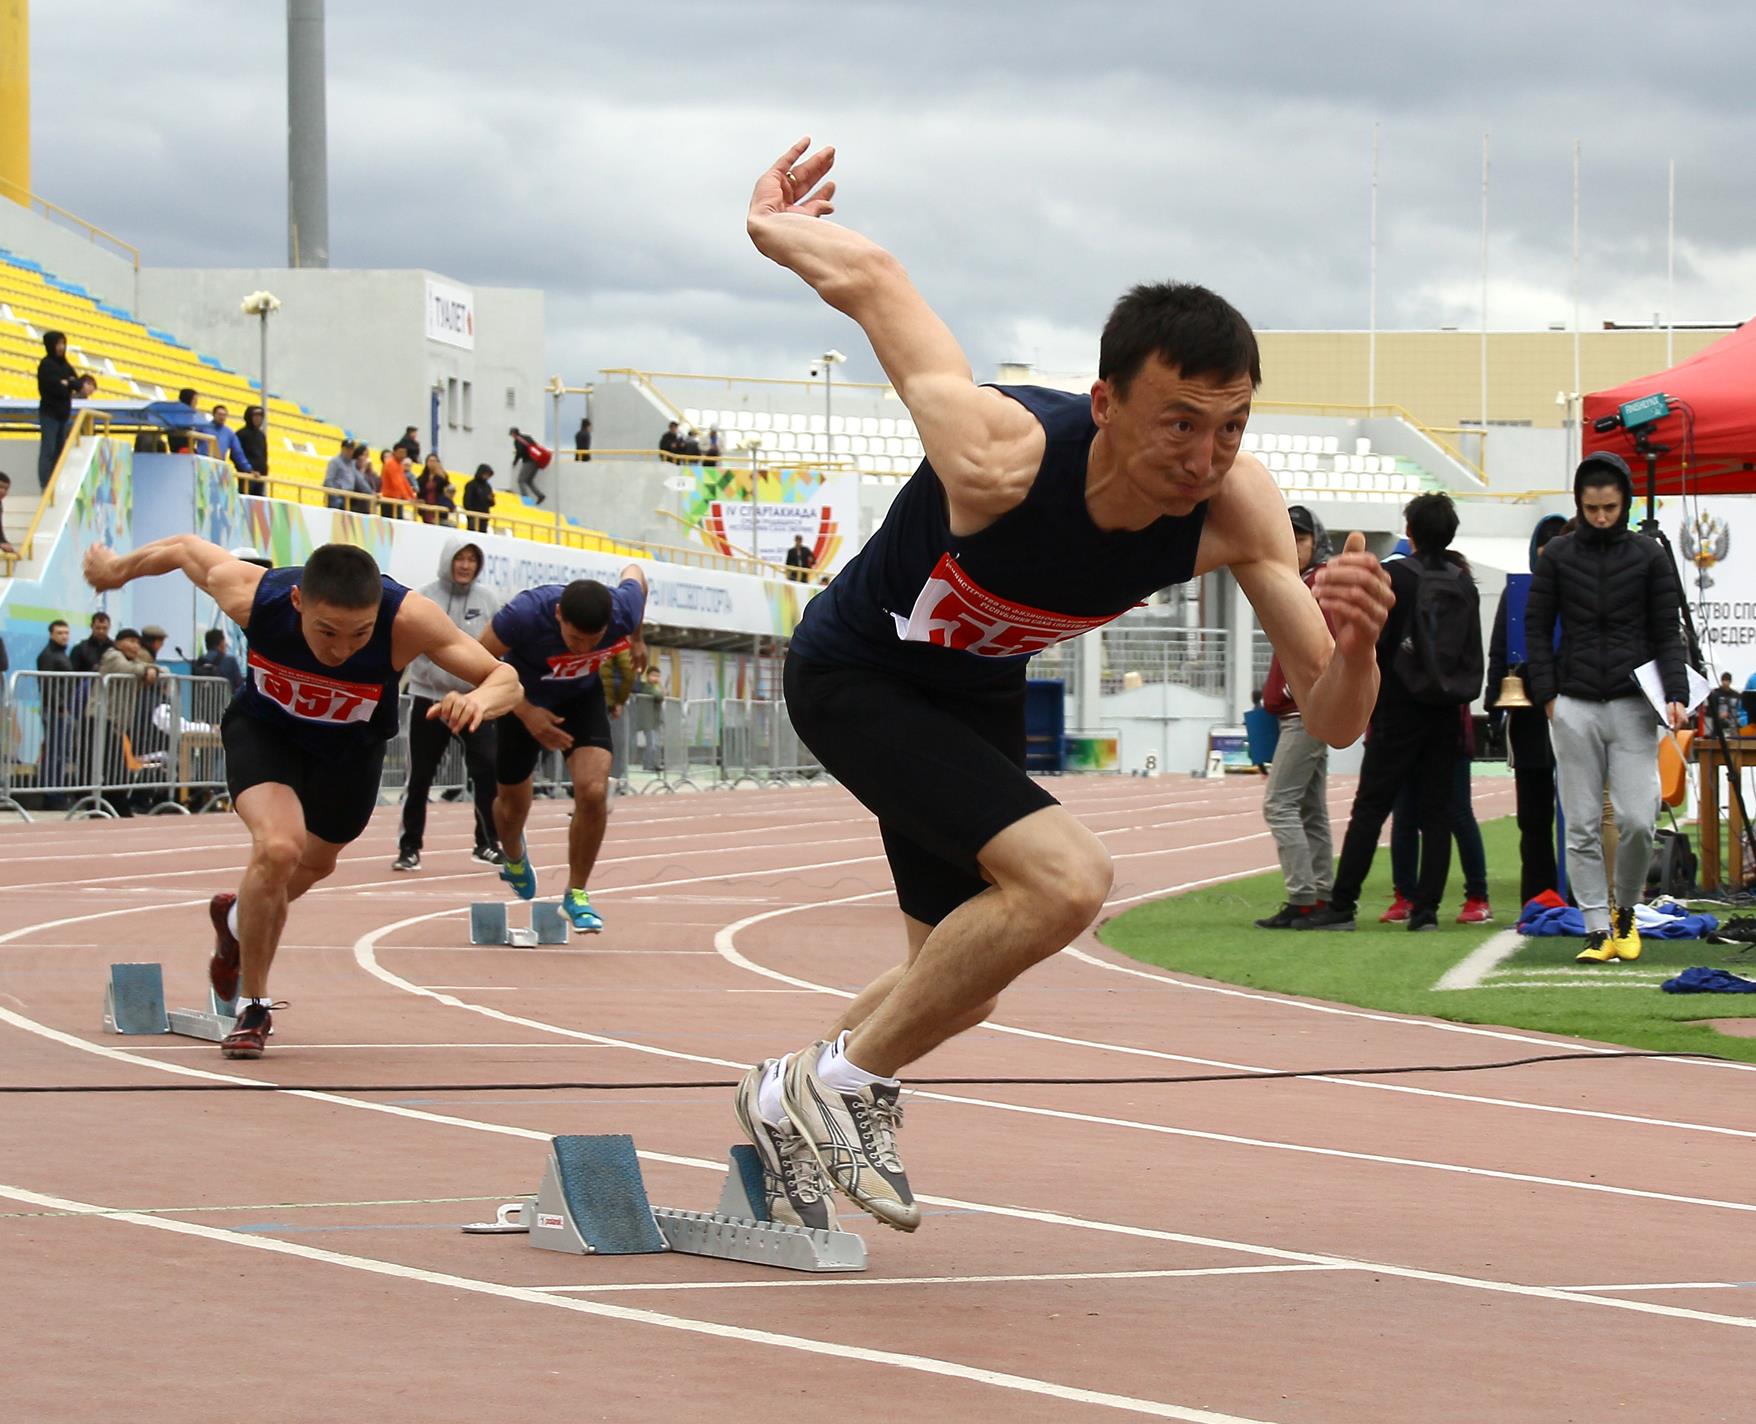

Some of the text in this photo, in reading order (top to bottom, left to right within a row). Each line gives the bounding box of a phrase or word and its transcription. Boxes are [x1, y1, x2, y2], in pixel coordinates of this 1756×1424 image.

[1688, 601, 1730, 619] РСТВО
[1709, 626, 1756, 647] ФЕДЕР
[1146, 755, 1220, 771] 8 7
